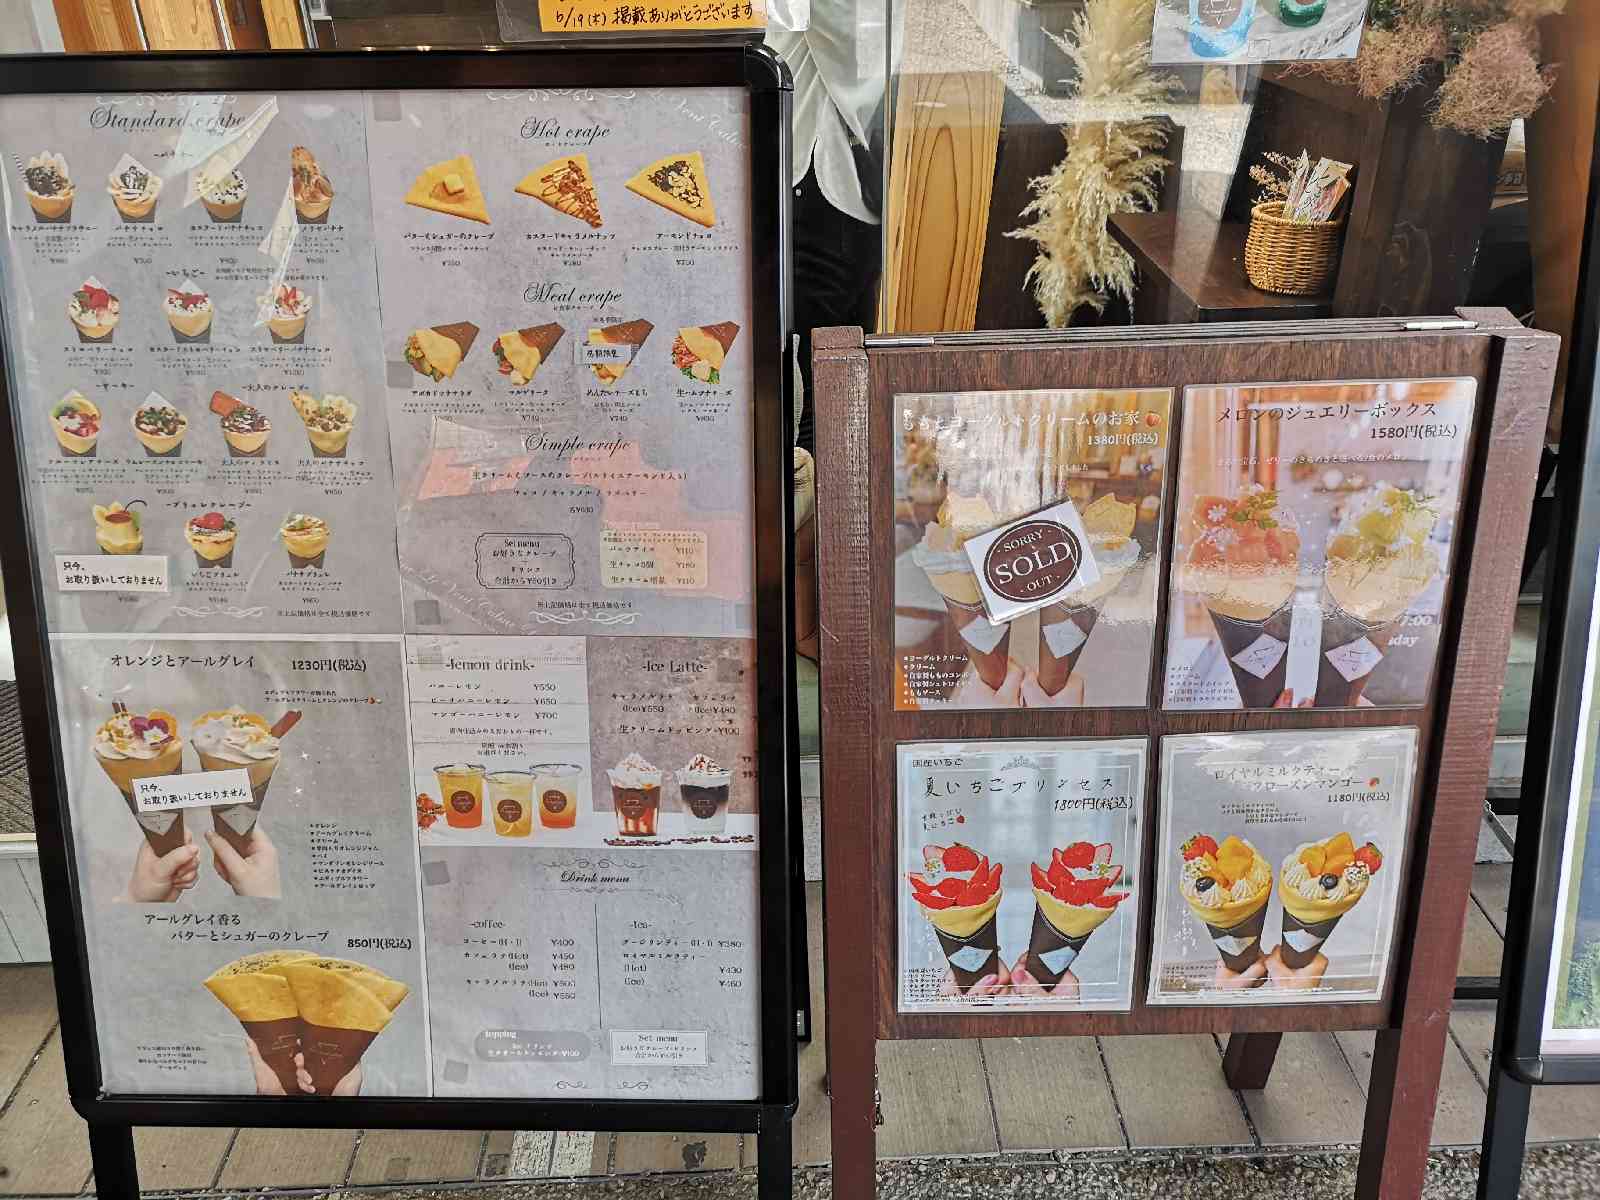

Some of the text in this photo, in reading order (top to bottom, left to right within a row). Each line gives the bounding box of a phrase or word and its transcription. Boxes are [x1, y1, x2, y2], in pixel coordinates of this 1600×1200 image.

[90, 103, 191, 129] Standard
[520, 116, 611, 146] Hot crape
[579, 289, 623, 310] crape
[1216, 401, 1438, 424] メロンのジュエリーボックス
[1370, 423, 1458, 441] 1580円(税込)
[525, 432, 632, 458] Simple crape
[1003, 529, 1043, 553] SORRY
[995, 541, 1072, 585] SOLD
[64, 573, 163, 587] お取り扱いしておりません
[1026, 573, 1053, 592] OUT
[111, 654, 367, 673] オレンジとアールグレイ 1230円(税込)
[912, 758, 964, 769] 国産いちご
[142, 788, 248, 806] お取り扱いしておりません
[923, 776, 1114, 799] 夏いちごプリンセス
[1053, 796, 1134, 812] 1800円(税込)
[144, 912, 242, 927] アールグレイ香る
[170, 929, 412, 950] バターとシュガーのクレープ 850円(税込)
